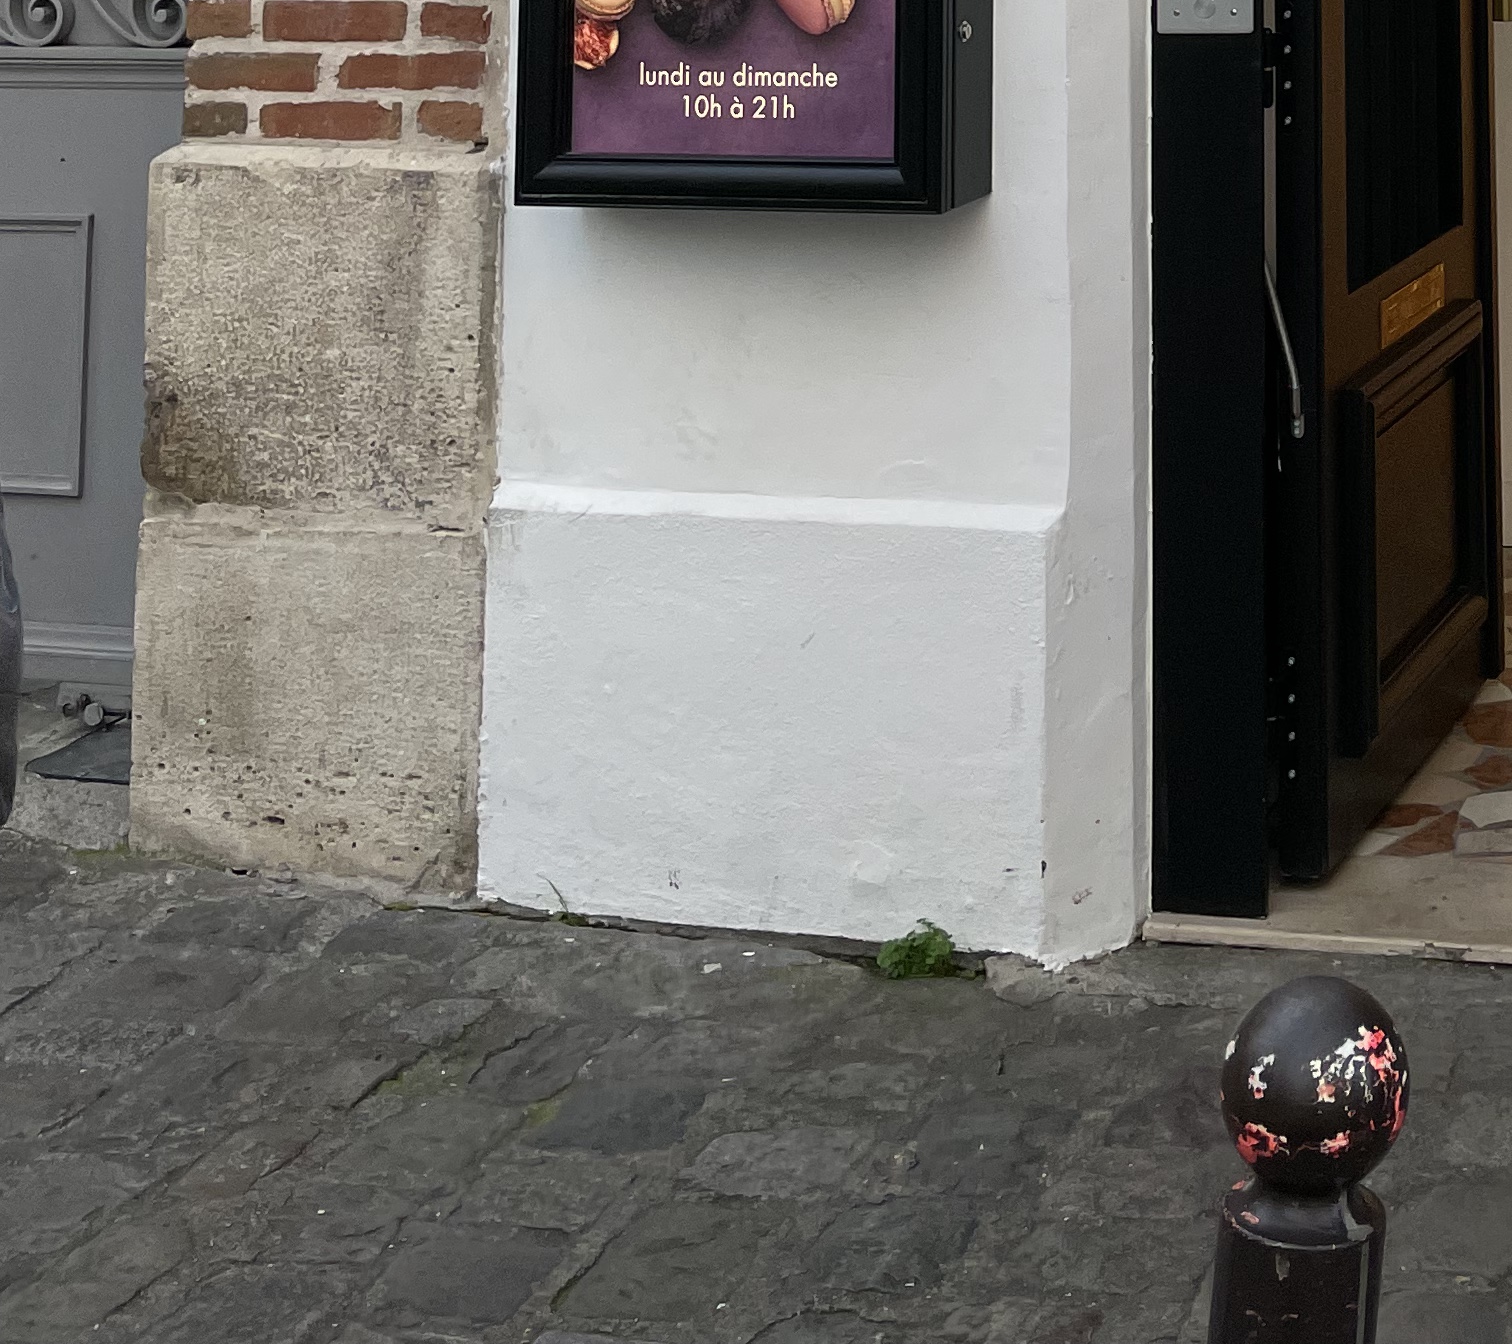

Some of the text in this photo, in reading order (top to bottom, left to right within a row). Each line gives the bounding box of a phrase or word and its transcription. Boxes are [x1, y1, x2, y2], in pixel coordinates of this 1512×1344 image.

[640, 62, 837, 87] lundi au dimanche
[683, 94, 794, 118] 10h à 21h
